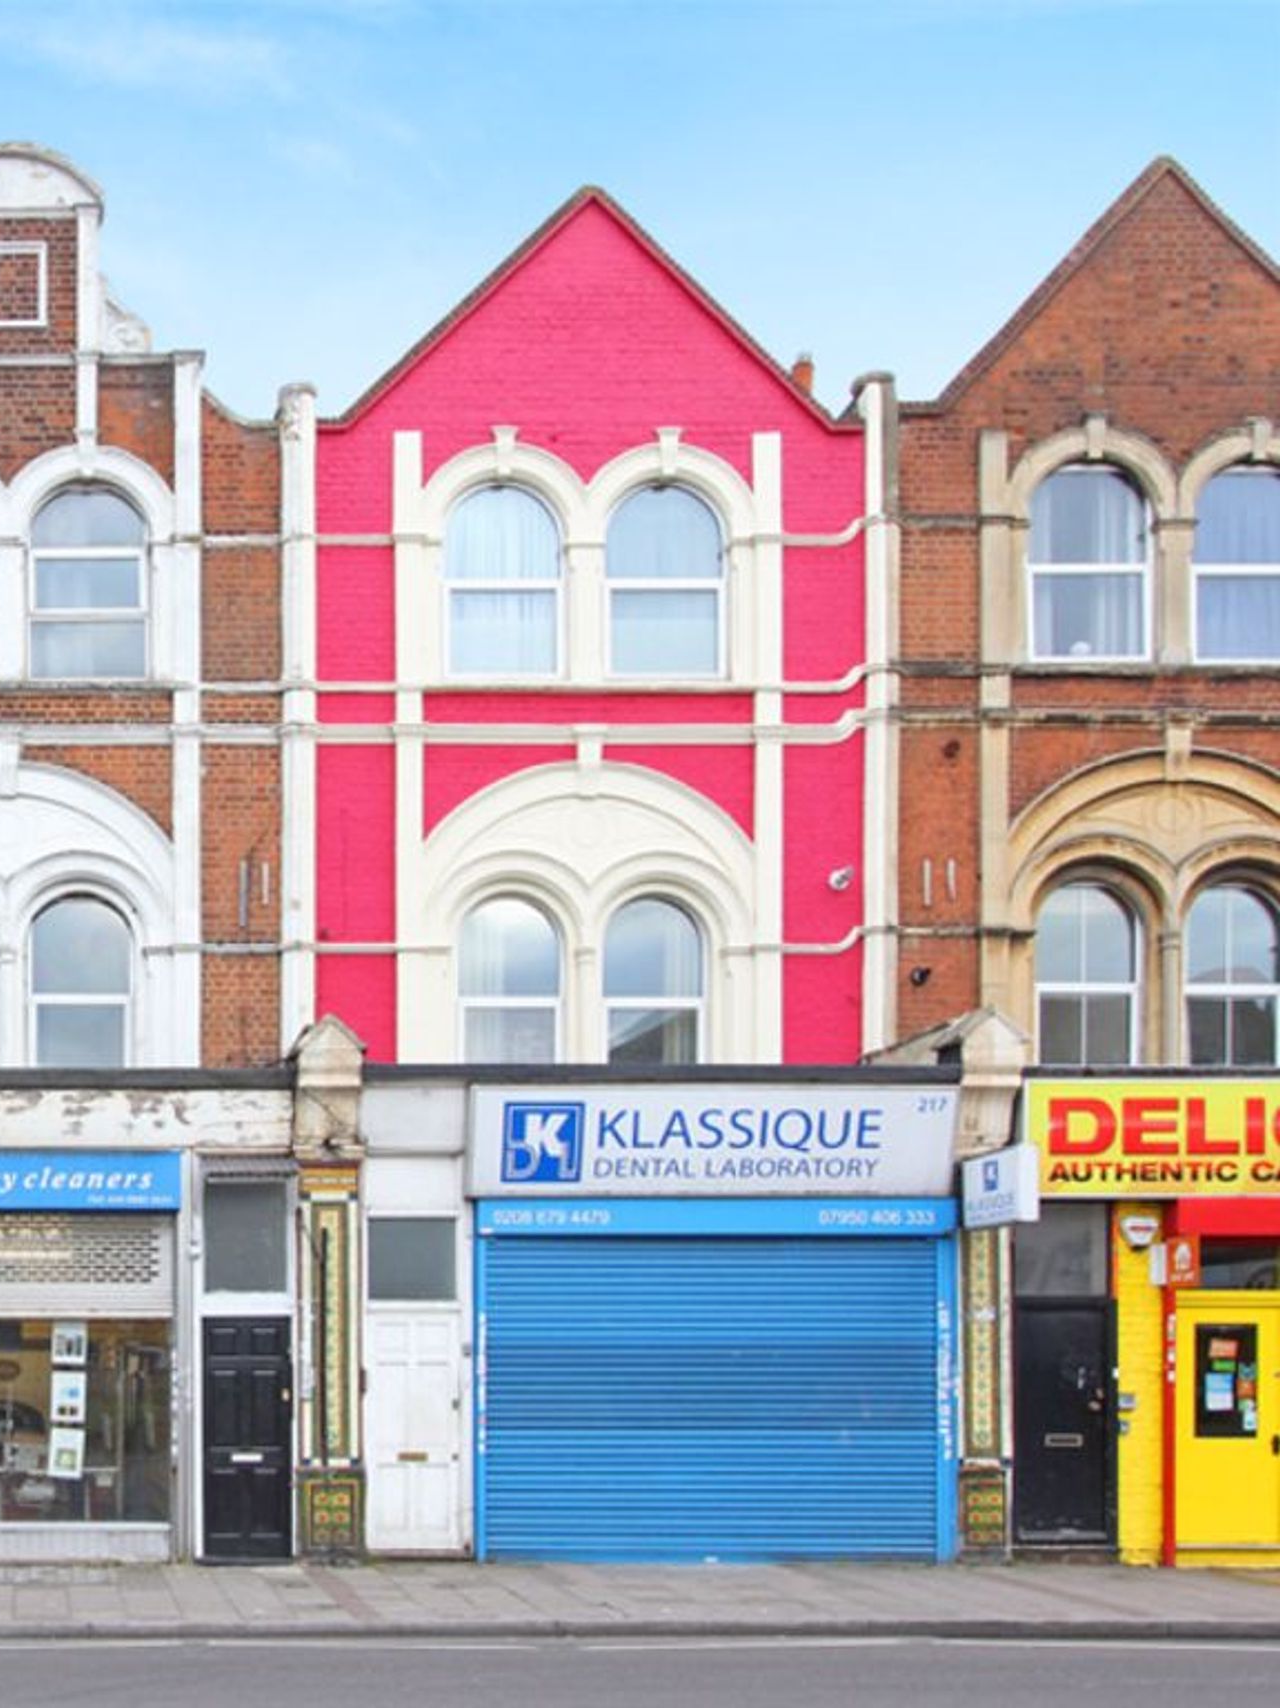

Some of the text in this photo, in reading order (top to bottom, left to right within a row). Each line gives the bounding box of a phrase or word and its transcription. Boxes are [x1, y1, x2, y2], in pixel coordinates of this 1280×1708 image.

[916, 1096, 948, 1113] 217
[597, 1109, 883, 1152] KLASSIQUE
[1049, 1097, 1280, 1156] DELI
[23, 1166, 153, 1190] cleaners
[594, 1156, 880, 1179] DENTAL LABORATORY
[1049, 1161, 1280, 1183] AUTHENTIC C
